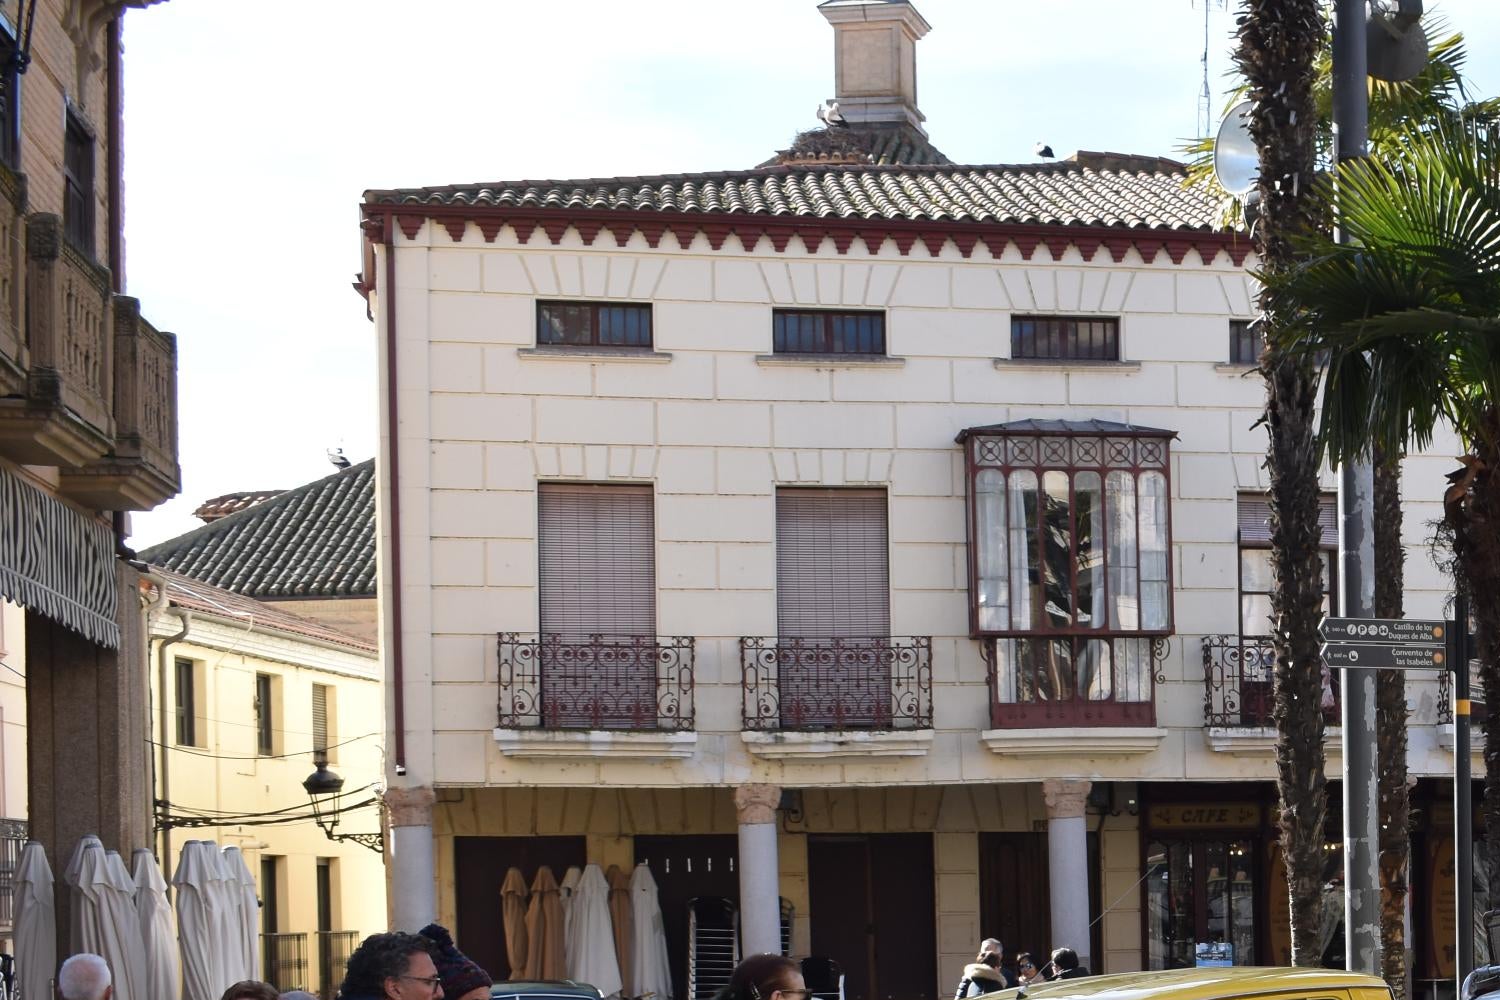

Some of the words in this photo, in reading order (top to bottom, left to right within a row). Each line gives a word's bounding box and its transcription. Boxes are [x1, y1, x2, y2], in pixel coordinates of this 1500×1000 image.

[1393, 623, 1414, 631] Castillo
[1388, 632, 1410, 641] Duques
[1392, 648, 1424, 656] Convento
[1425, 649, 1433, 657] de
[1407, 658, 1433, 666] Isabeles
